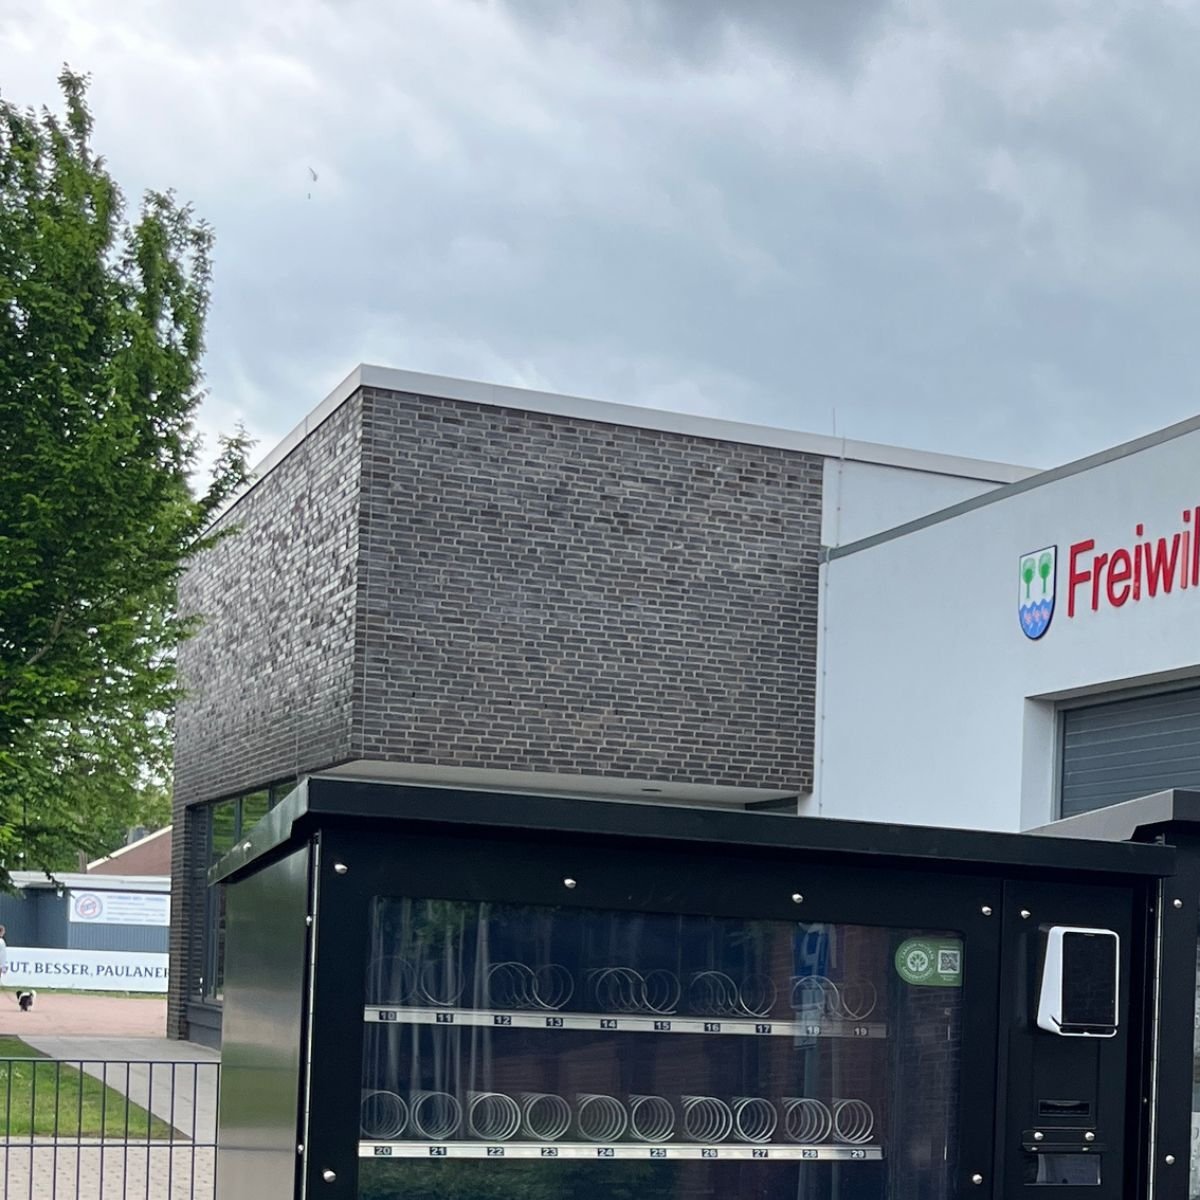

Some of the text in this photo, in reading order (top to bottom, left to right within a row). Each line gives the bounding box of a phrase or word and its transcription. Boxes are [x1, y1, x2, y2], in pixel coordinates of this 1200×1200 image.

[381, 1011, 395, 1021] 10
[438, 1013, 452, 1023] 11
[495, 1016, 509, 1025] 12
[547, 1018, 561, 1027] 13
[602, 1019, 616, 1029] 14
[655, 1021, 669, 1031] 15
[705, 1023, 719, 1032] 16
[756, 1024, 770, 1034] 17
[854, 1027, 868, 1036] 19
[376, 1146, 390, 1156] 20
[431, 1146, 445, 1156] 21
[543, 1147, 557, 1157] 23
[599, 1148, 613, 1157] 24
[651, 1148, 665, 1158] 25
[703, 1148, 717, 1158] 26
[754, 1149, 768, 1158] 27
[851, 1149, 865, 1159] 29
